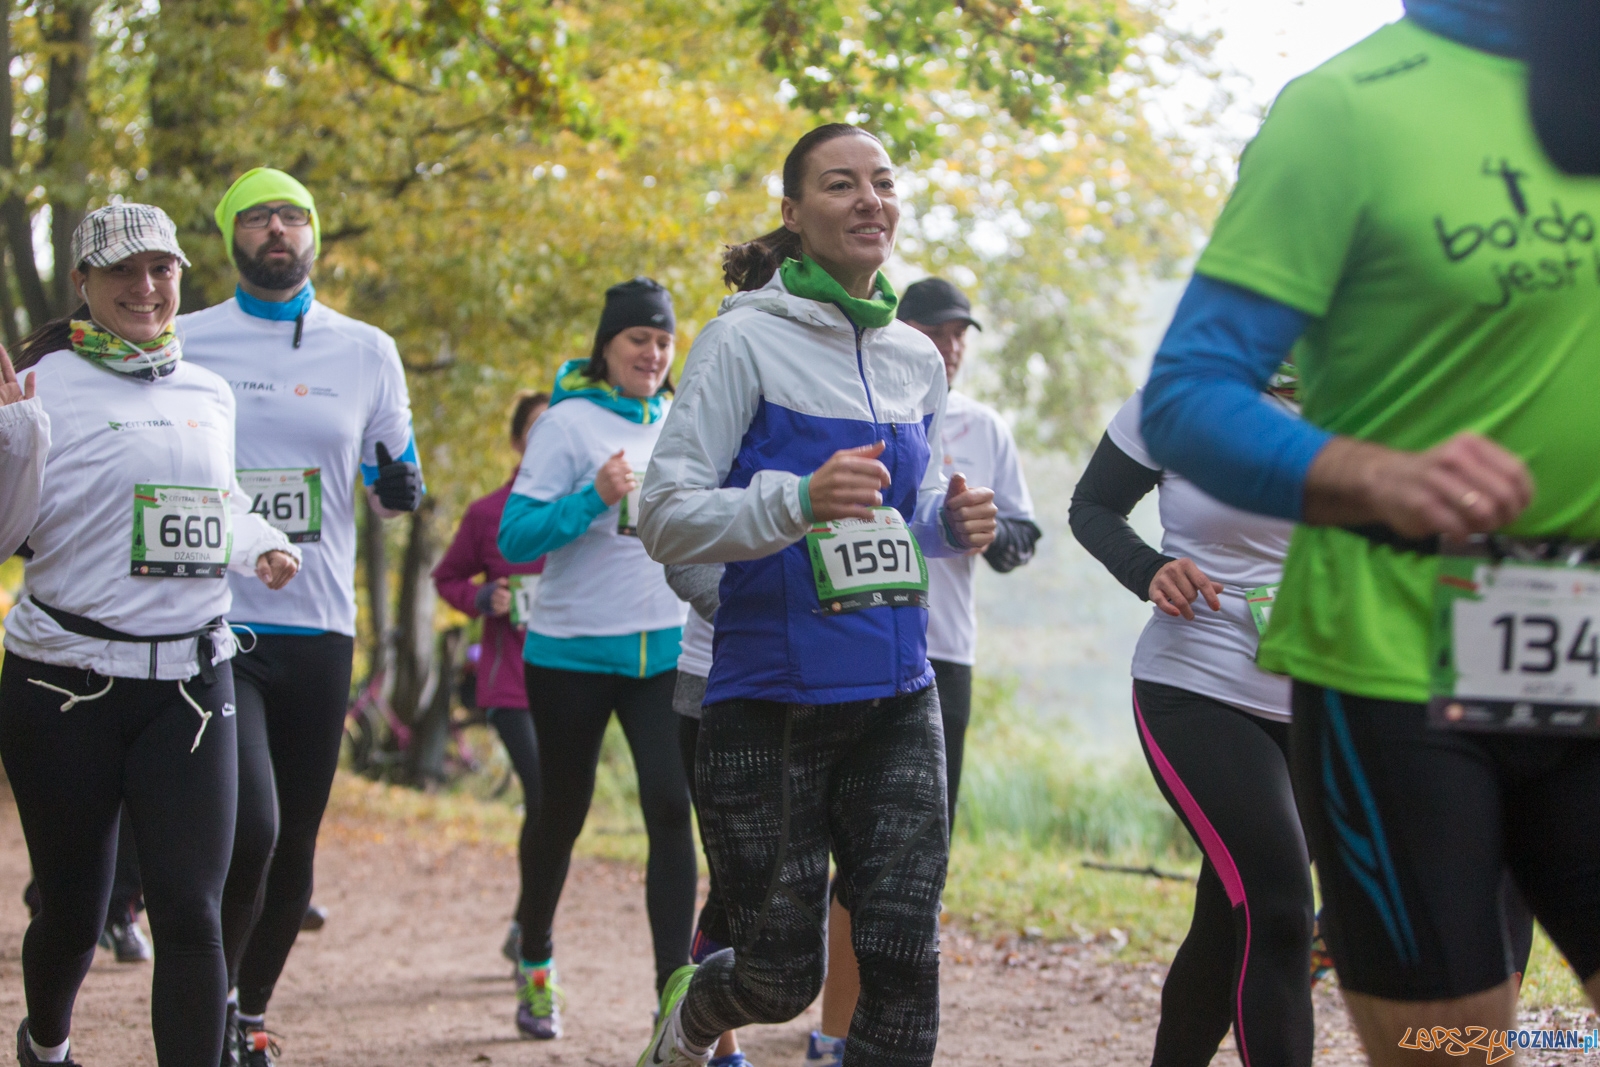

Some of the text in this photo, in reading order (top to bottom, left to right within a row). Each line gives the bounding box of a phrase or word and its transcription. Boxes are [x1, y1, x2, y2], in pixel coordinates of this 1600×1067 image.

[247, 490, 305, 521] 461
[159, 514, 222, 549] 660
[834, 538, 910, 577] 1597
[1492, 612, 1600, 676] 134
